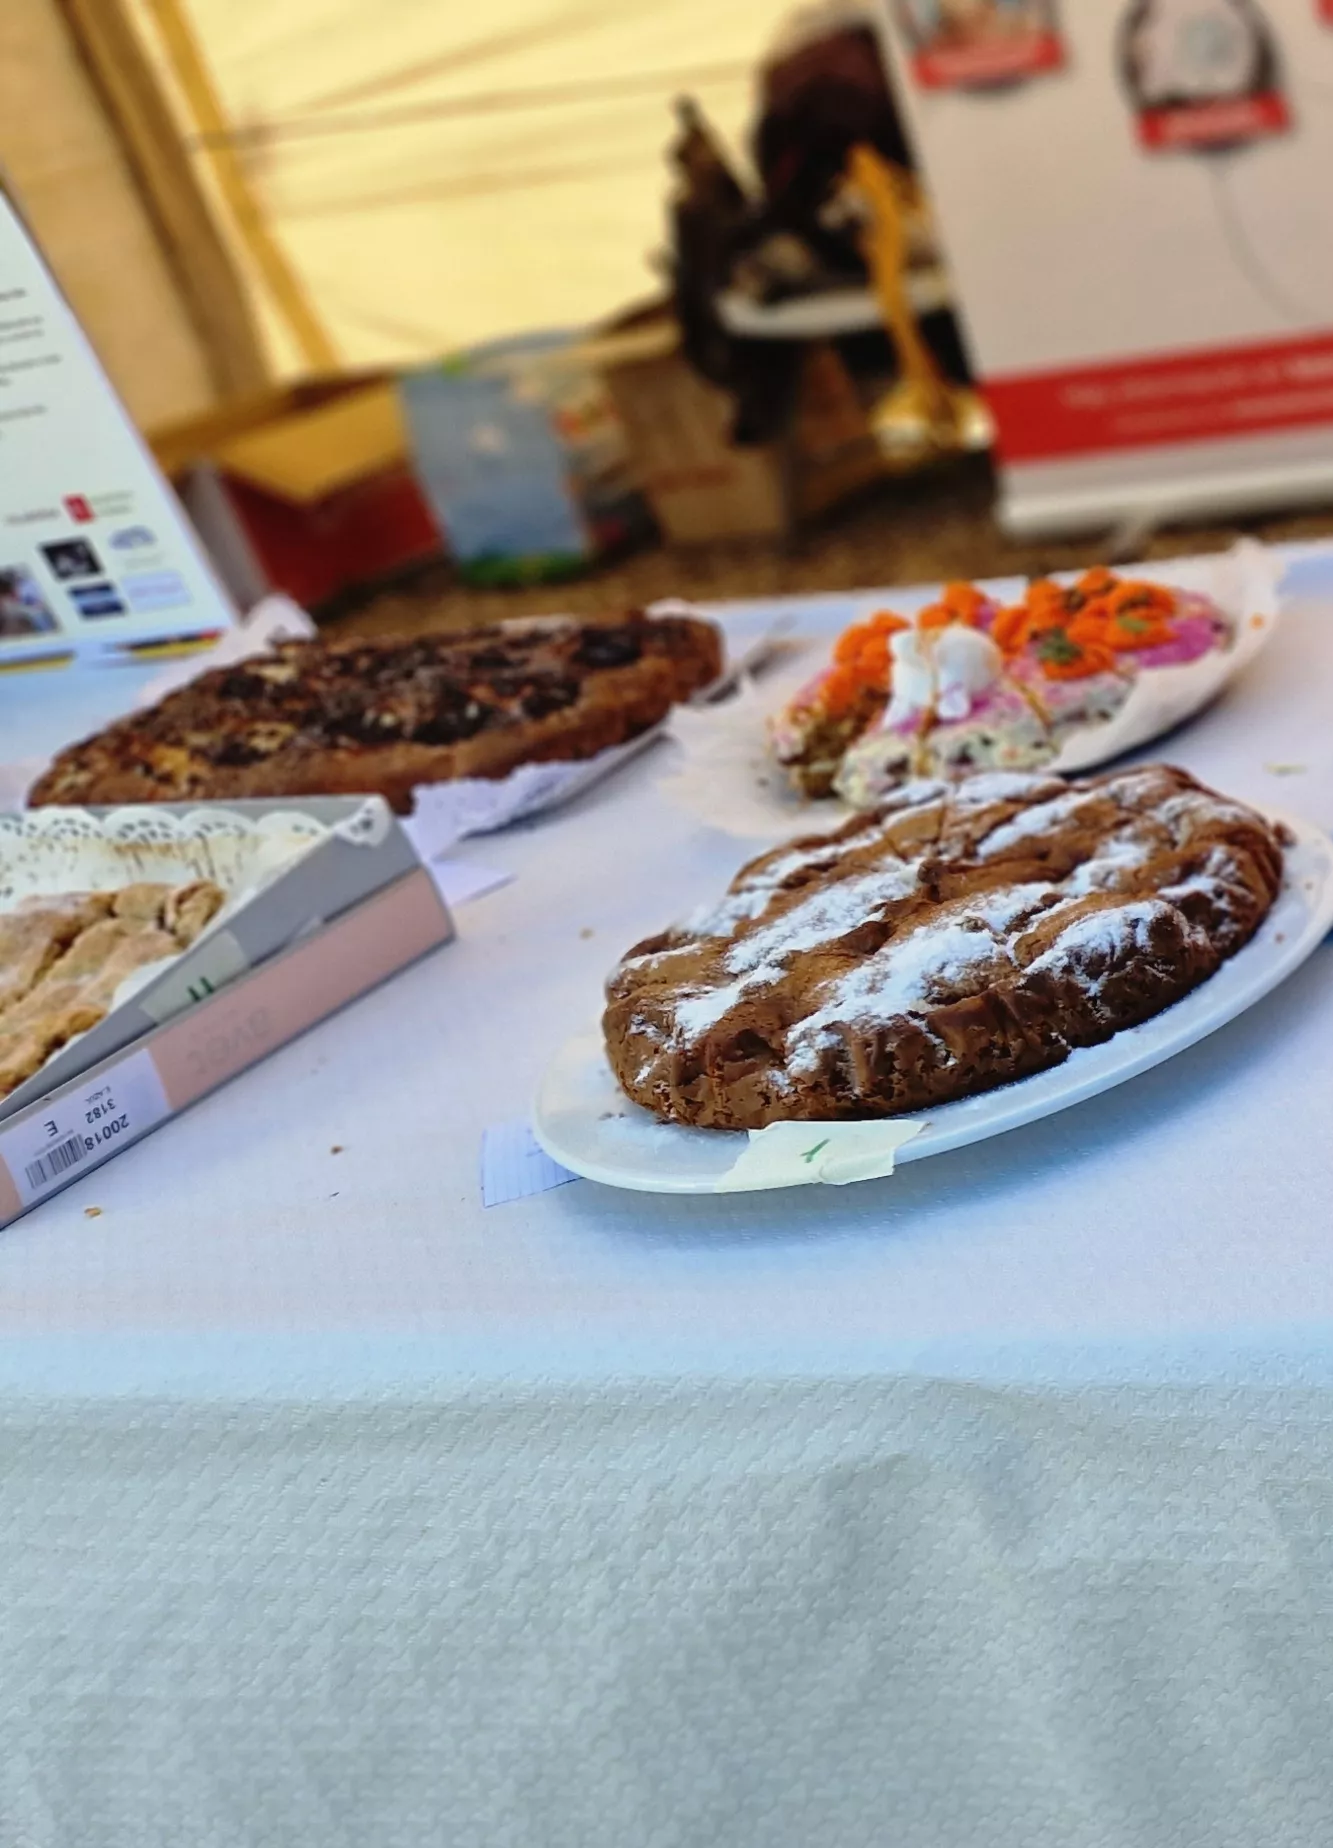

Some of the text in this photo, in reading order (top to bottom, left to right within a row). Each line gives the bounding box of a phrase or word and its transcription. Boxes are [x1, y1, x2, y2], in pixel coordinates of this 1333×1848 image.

[84, 1097, 116, 1124] 3182
[43, 1119, 59, 1137] E
[84, 1113, 130, 1151] 20018
